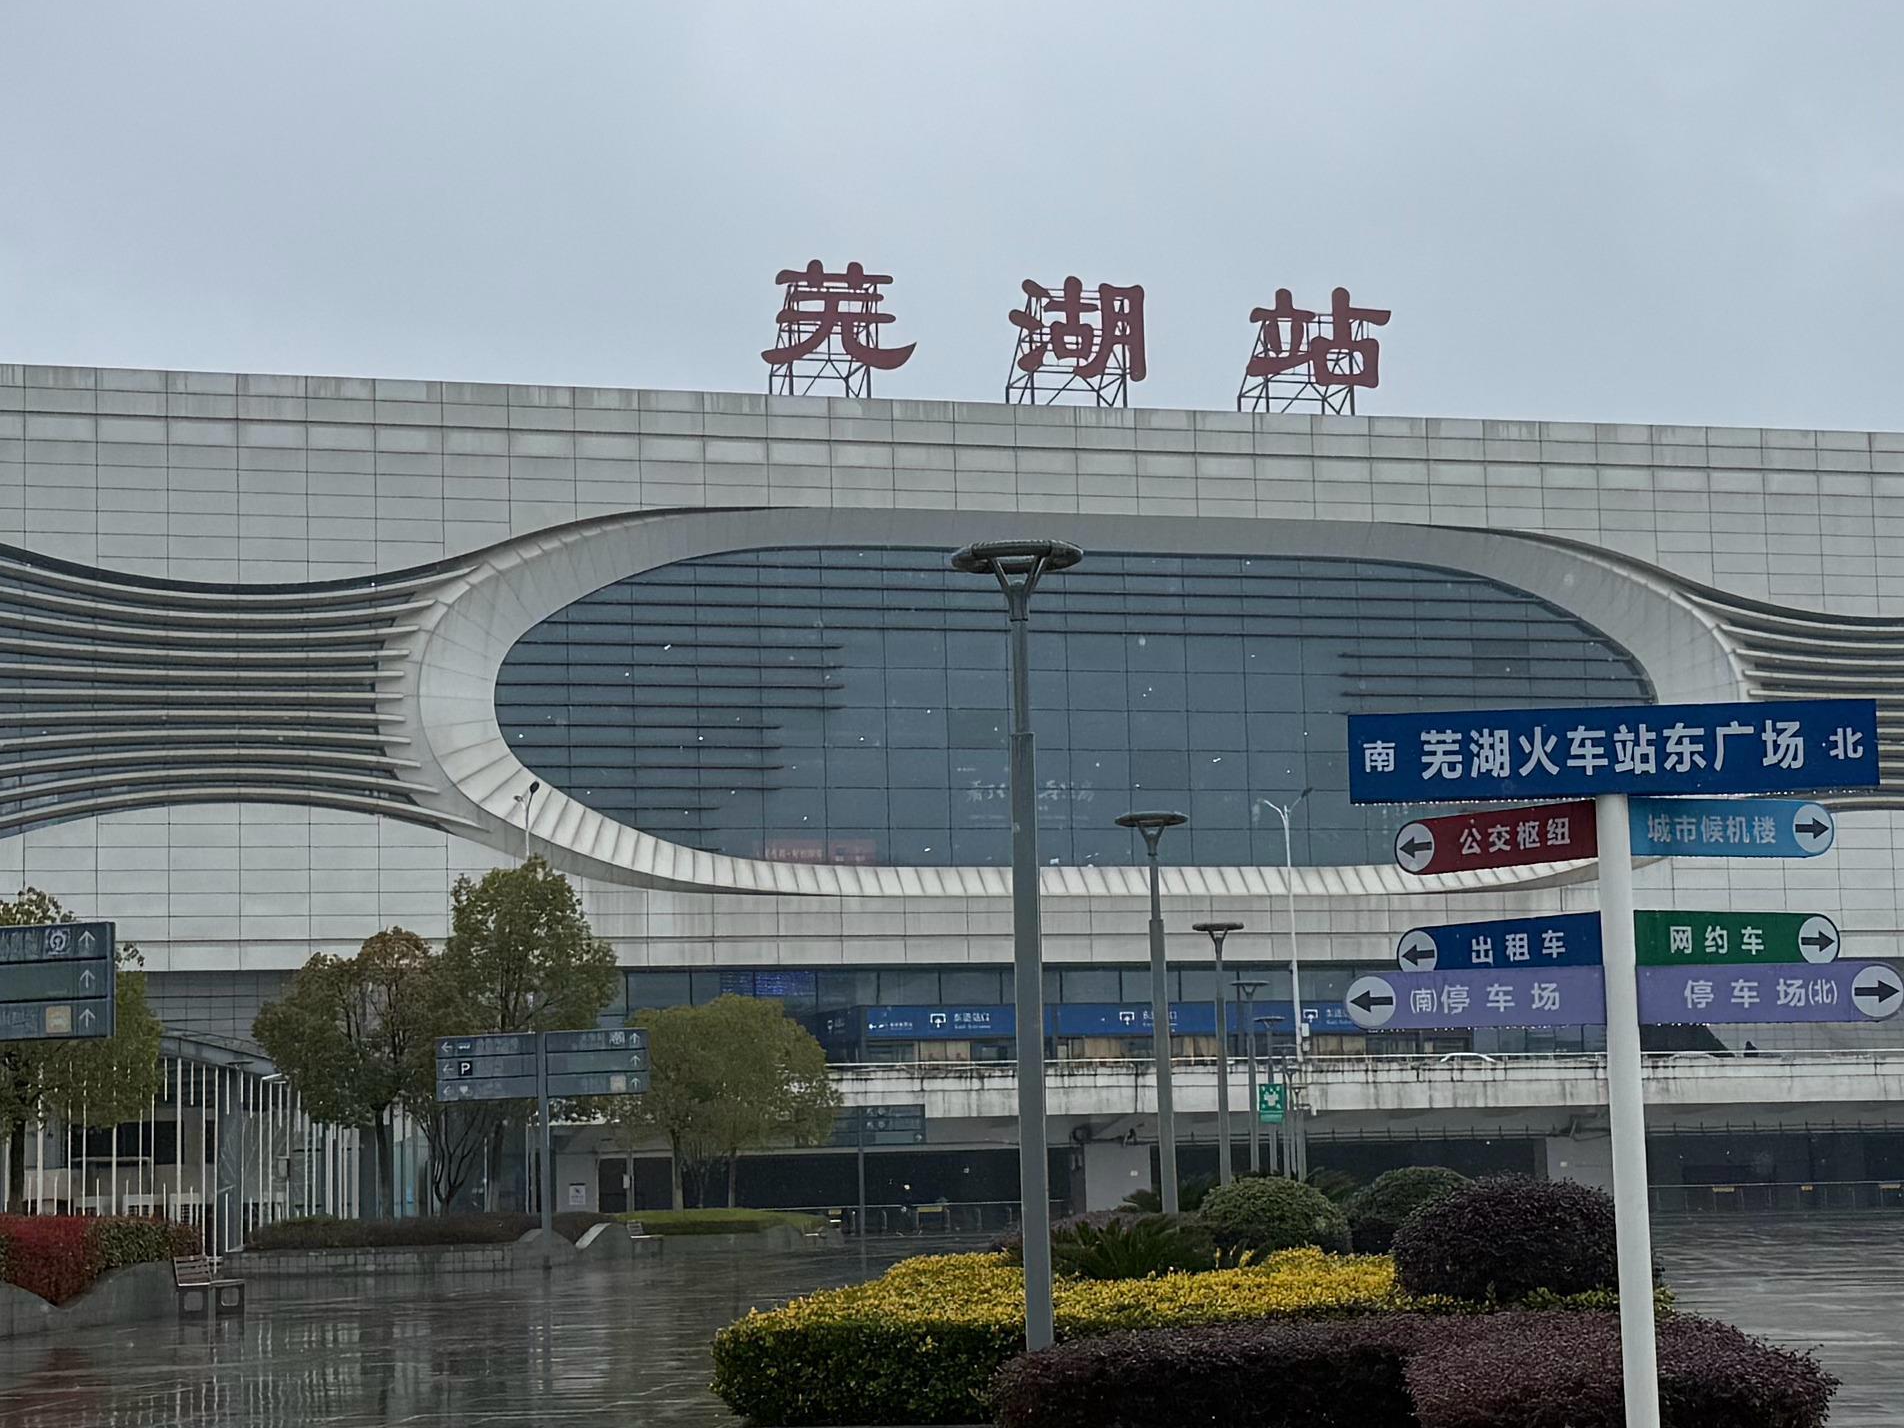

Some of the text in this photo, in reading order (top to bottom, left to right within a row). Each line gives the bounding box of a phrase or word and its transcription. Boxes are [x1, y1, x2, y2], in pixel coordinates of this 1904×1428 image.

[760, 259, 1391, 388] 芜湖站
[1363, 720, 1864, 780] 南 芜湖火车站东广场 北
[1459, 816, 1571, 855] 公交枢纽
[1647, 813, 1777, 844] 城市候机楼
[1471, 928, 1567, 965] 出租车
[1669, 925, 1765, 955] 网约车
